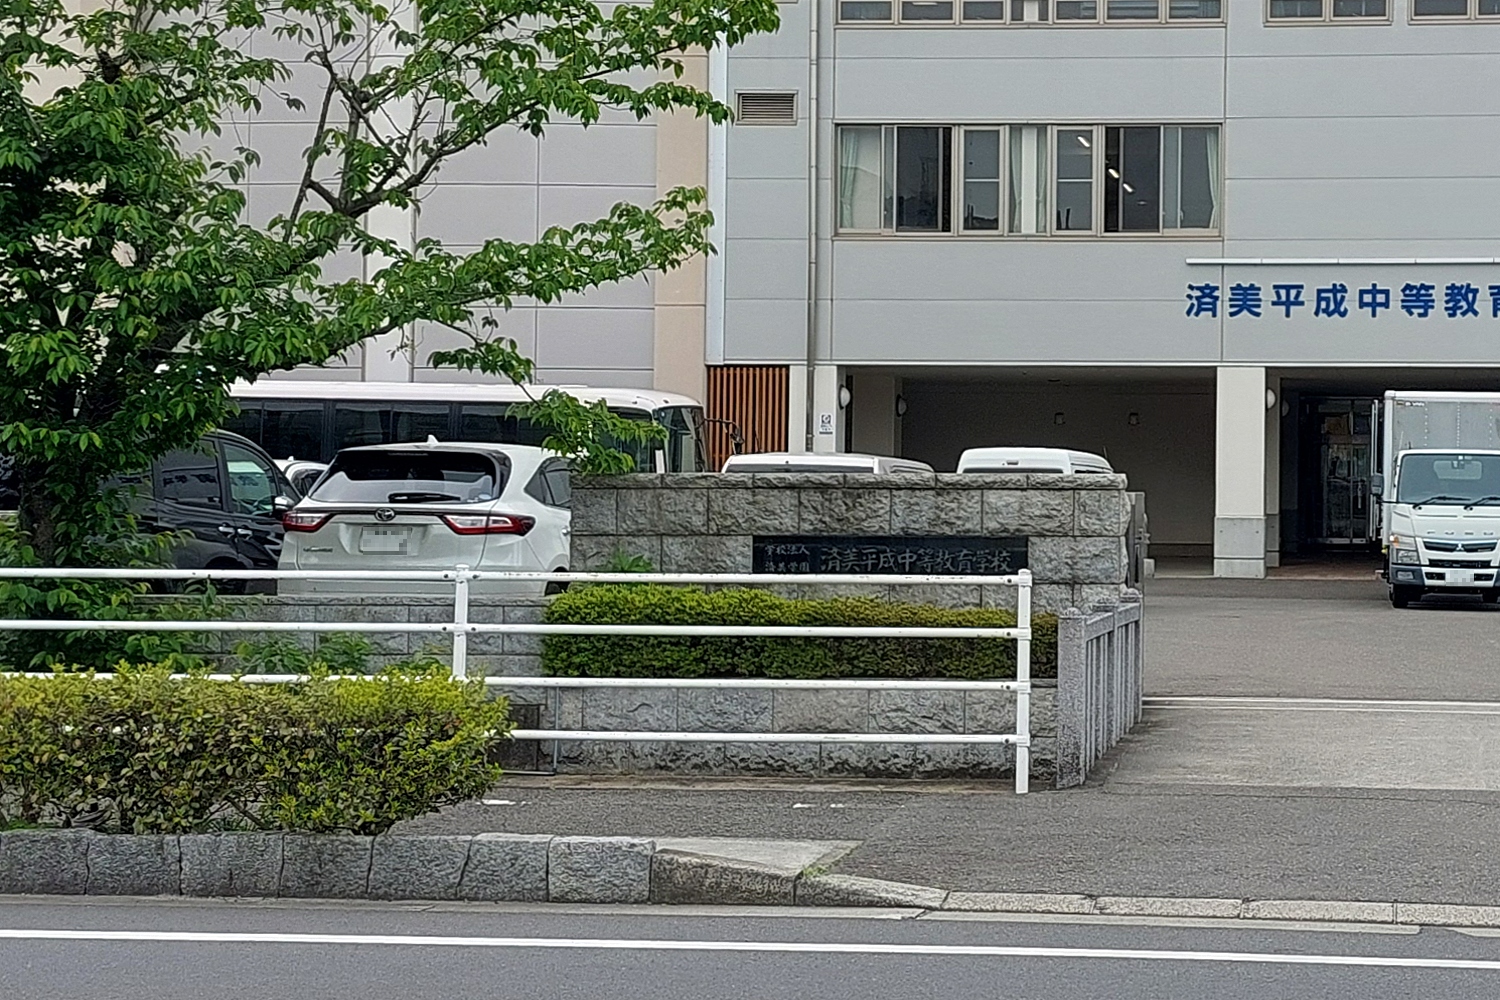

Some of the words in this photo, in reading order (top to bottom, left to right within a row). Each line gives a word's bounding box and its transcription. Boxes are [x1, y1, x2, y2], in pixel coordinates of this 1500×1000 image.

[820, 547, 1014, 573] 済美平成中等教育学校
